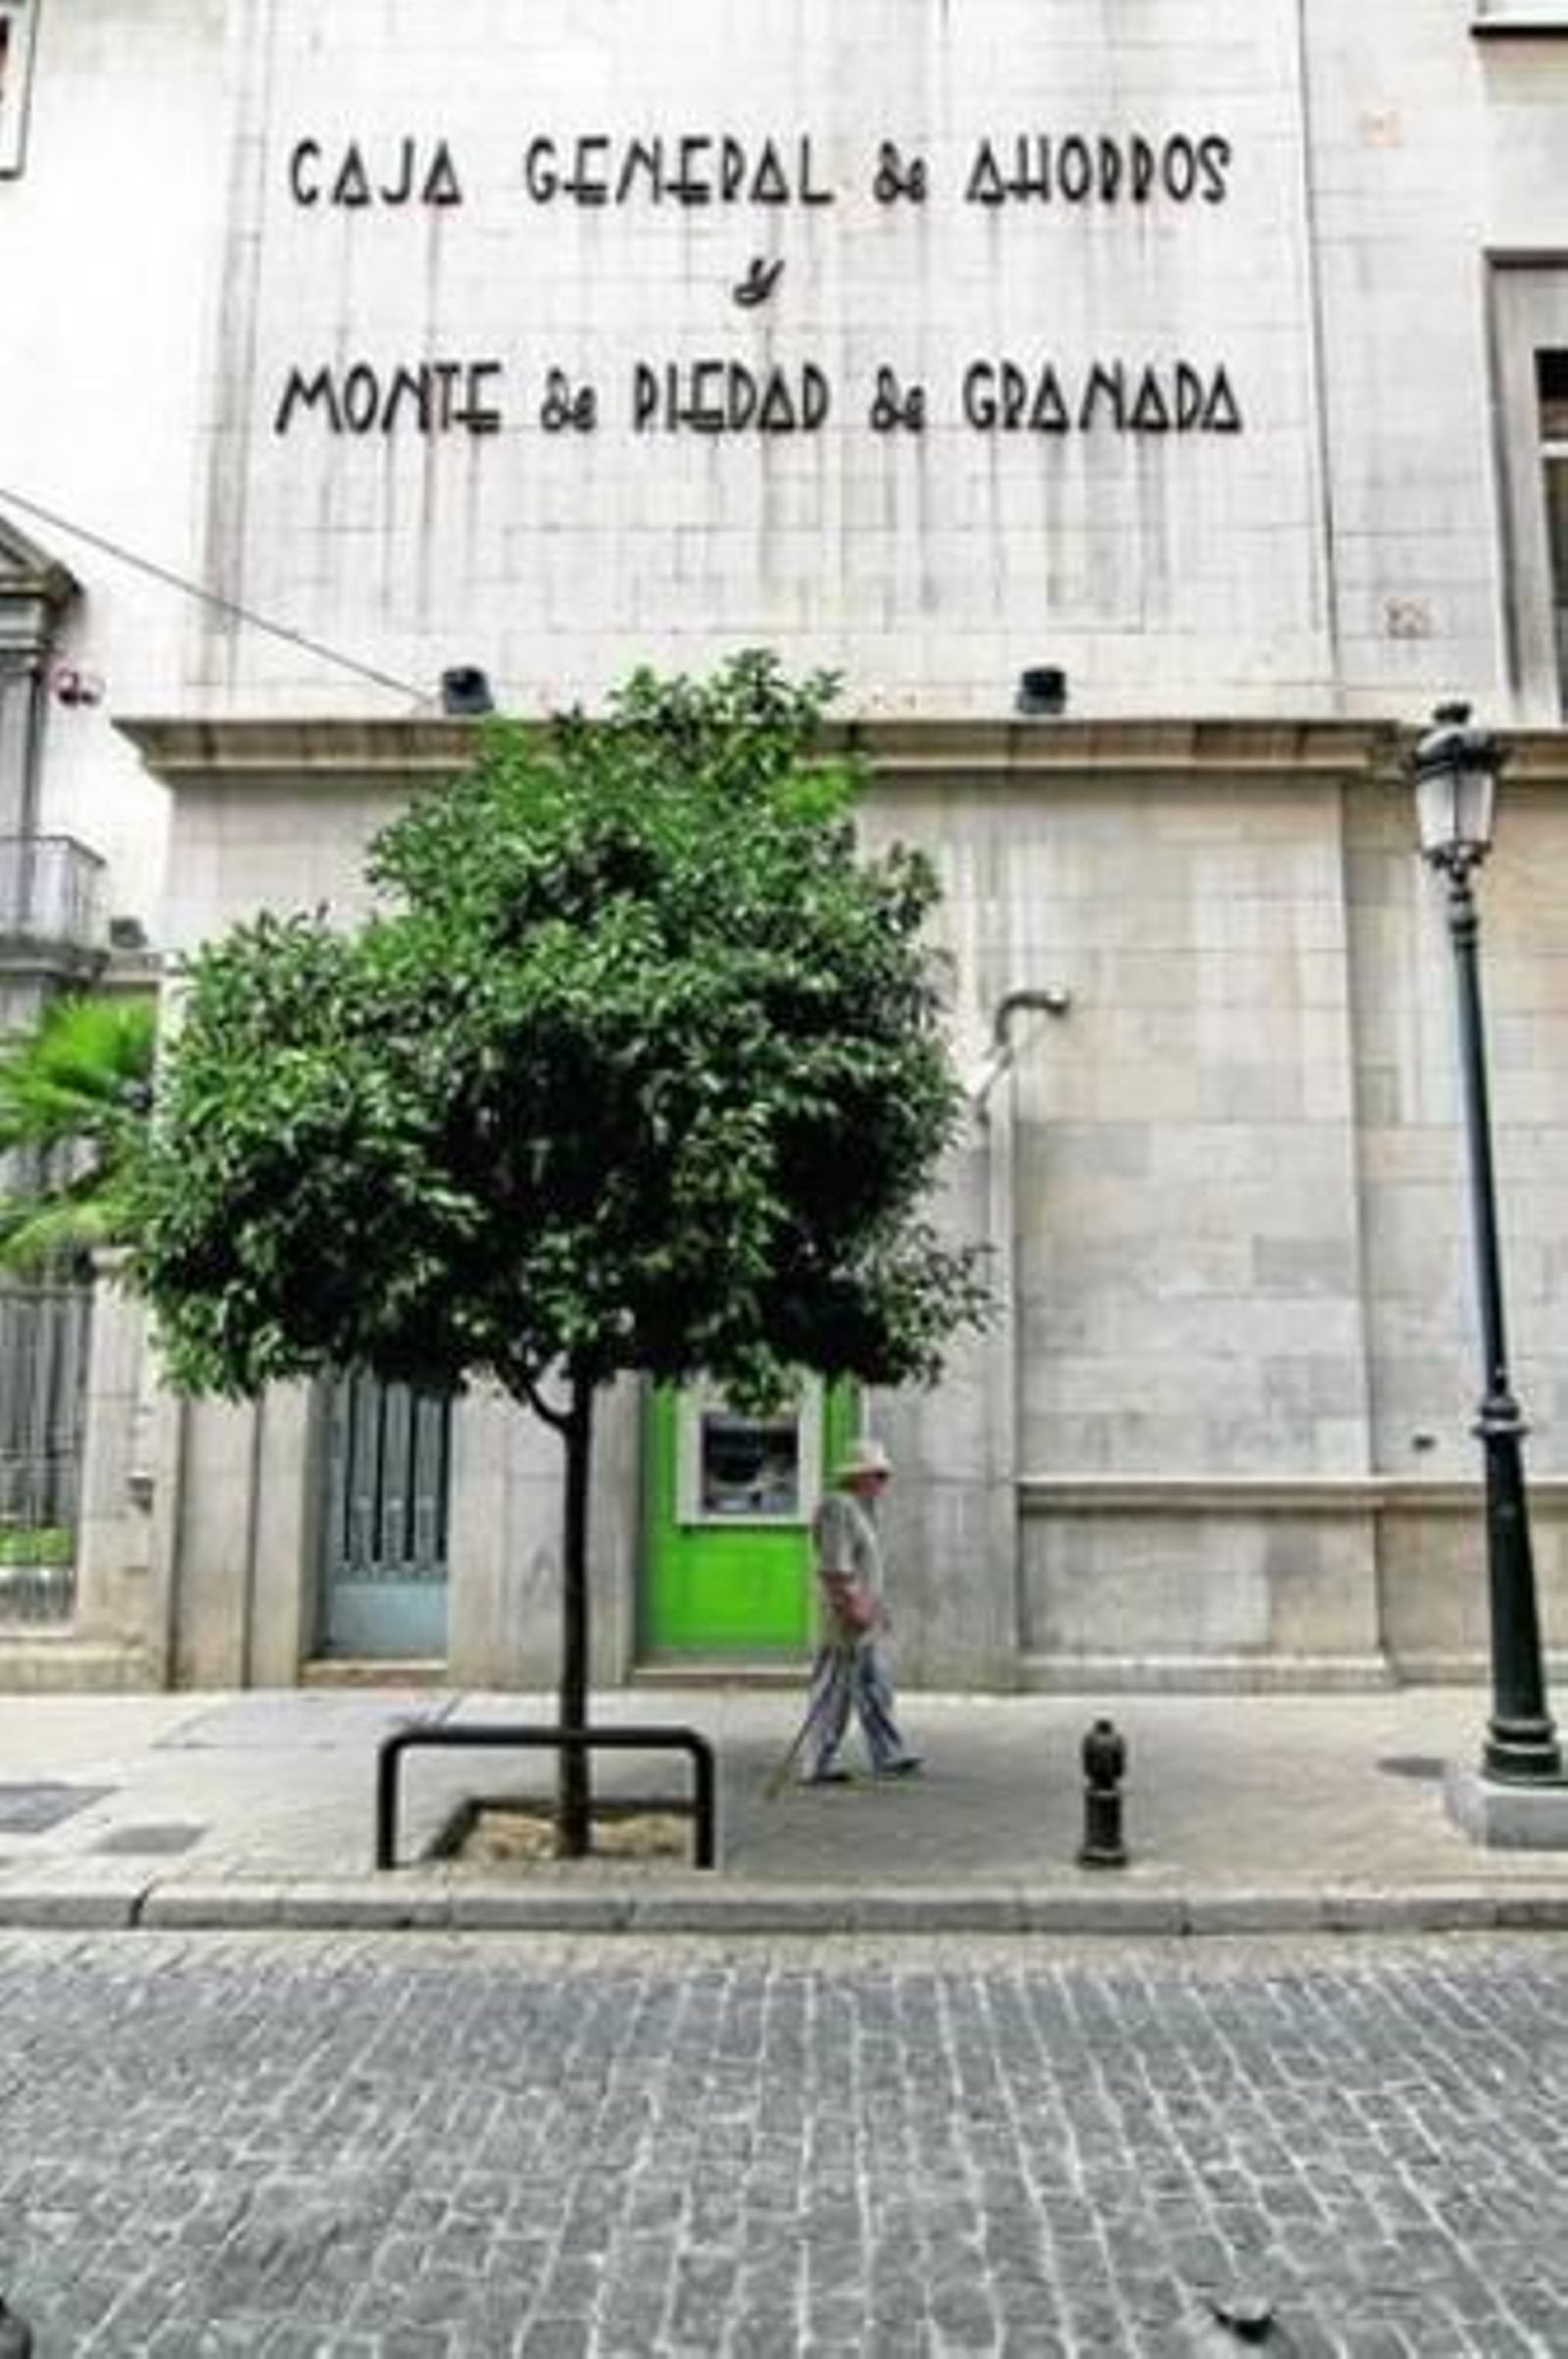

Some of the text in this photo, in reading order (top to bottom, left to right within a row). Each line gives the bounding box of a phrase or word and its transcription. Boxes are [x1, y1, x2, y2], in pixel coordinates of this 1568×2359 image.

[289, 133, 1232, 207] CAJA GENERAL de AHORROS
[273, 359, 1244, 435] MONTE de PIEDAD de GRANADA
